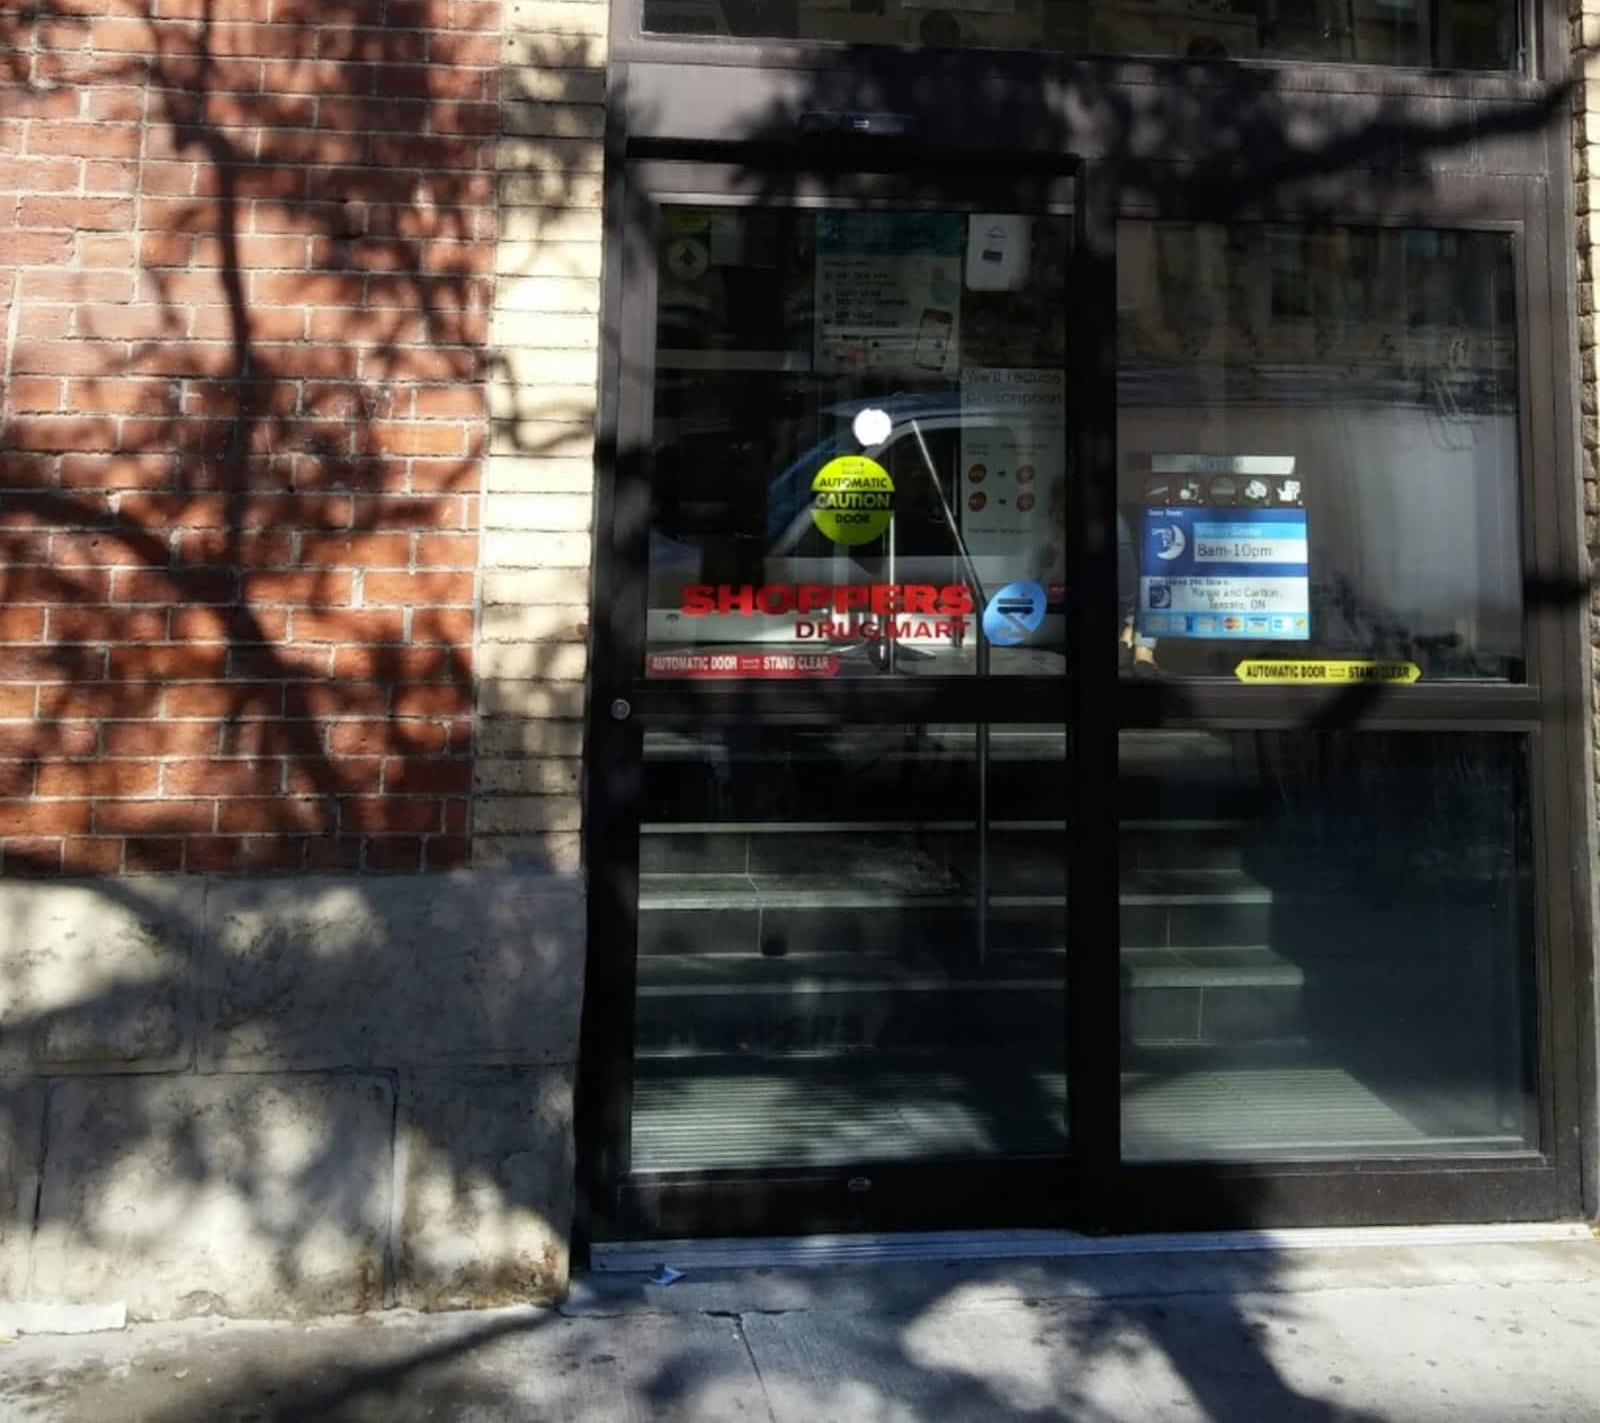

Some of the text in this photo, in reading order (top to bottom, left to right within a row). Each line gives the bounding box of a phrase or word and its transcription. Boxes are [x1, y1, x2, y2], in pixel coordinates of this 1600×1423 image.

[819, 477, 888, 488] AUTOMATIC
[816, 492, 891, 509] CAUTION
[835, 513, 871, 524] DOOR
[679, 583, 973, 616] SHOPPERS
[795, 620, 971, 640] DRUG MART
[652, 656, 829, 670] AUTOMATIC DOOR STAND CLEAR
[1245, 665, 1298, 679] AUTOMATIC
[1300, 665, 1326, 679] DOOR
